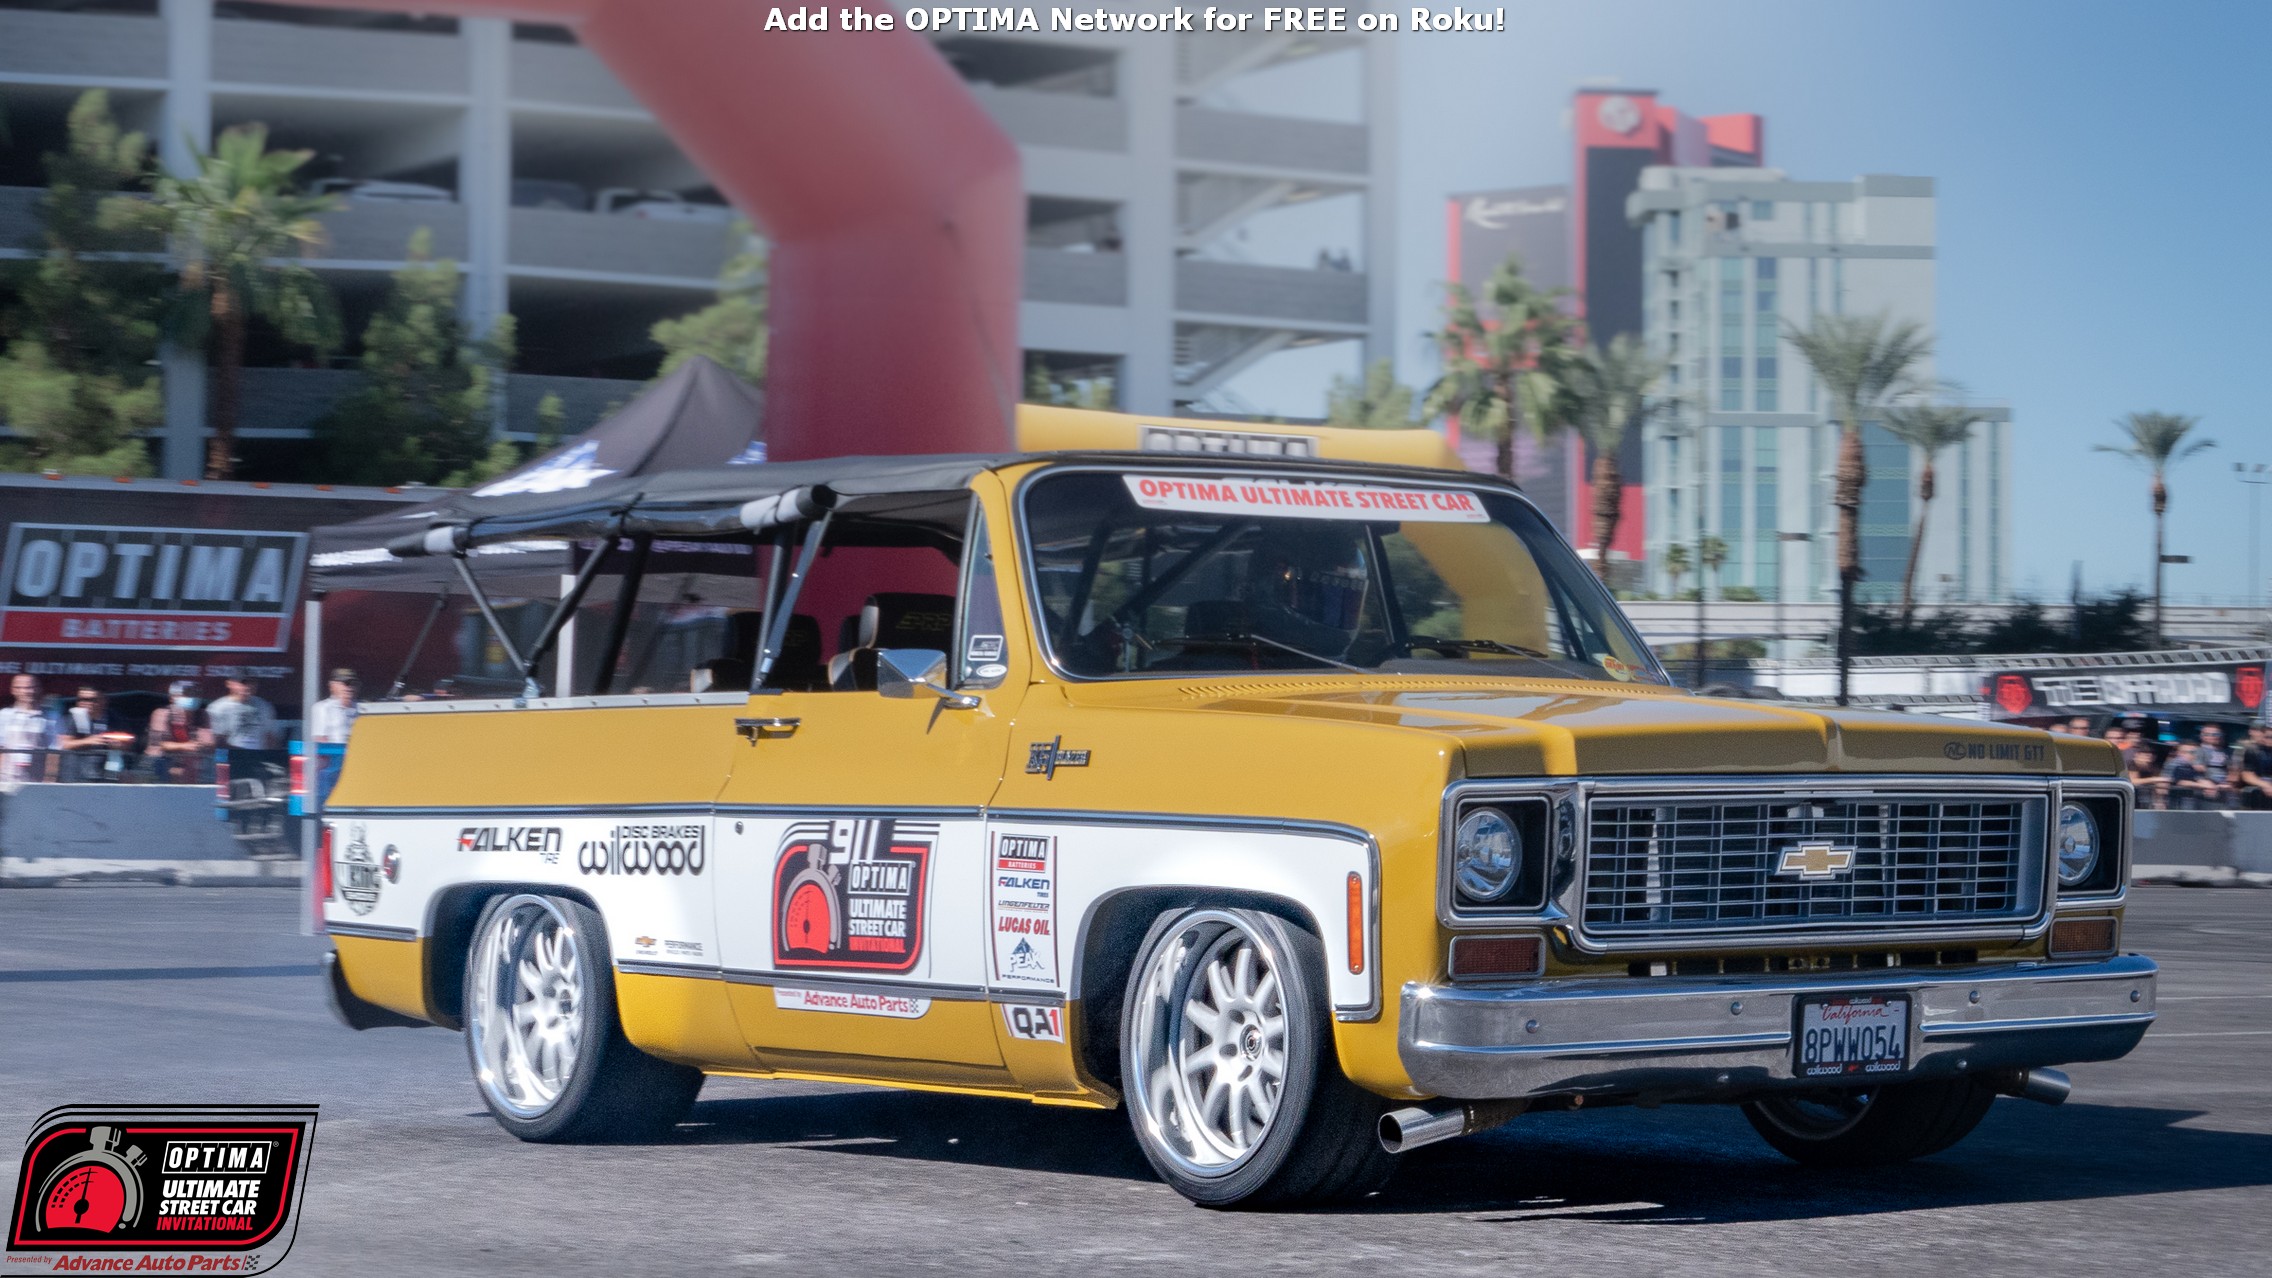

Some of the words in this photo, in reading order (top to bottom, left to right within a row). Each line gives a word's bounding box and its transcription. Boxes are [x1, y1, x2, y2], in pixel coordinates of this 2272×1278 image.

[1138, 478, 1238, 503] OPTIMA
[1241, 486, 1355, 508] ULTIMATE
[1359, 491, 1429, 511] STREET
[1431, 493, 1476, 512] CAR
[15, 539, 285, 602] OPTIMA
[60, 618, 232, 641] BATTERIES
[457, 827, 563, 851] FALKEN
[621, 825, 648, 839] DISC
[651, 825, 700, 839] BRAKES
[829, 818, 880, 864] 911
[577, 824, 705, 876] wilwood
[1001, 836, 1046, 860] OPTIMA
[852, 866, 907, 890] OPTIMA
[998, 876, 1050, 890] FALKEN
[849, 899, 907, 919] ULTIMATE
[849, 919, 884, 936] STREET
[884, 920, 907, 937] CAR
[998, 916, 1031, 935] LUCAS
[1033, 919, 1051, 936] OIL
[1009, 950, 1046, 973] PEAK
[804, 991, 848, 1008] Advance
[850, 993, 878, 1010] Auto
[879, 995, 909, 1012] Parts
[1012, 1006, 1060, 1039] QA1
[1822, 1004, 1889, 1025] California
[1804, 1025, 1901, 1063] 8PWW054
